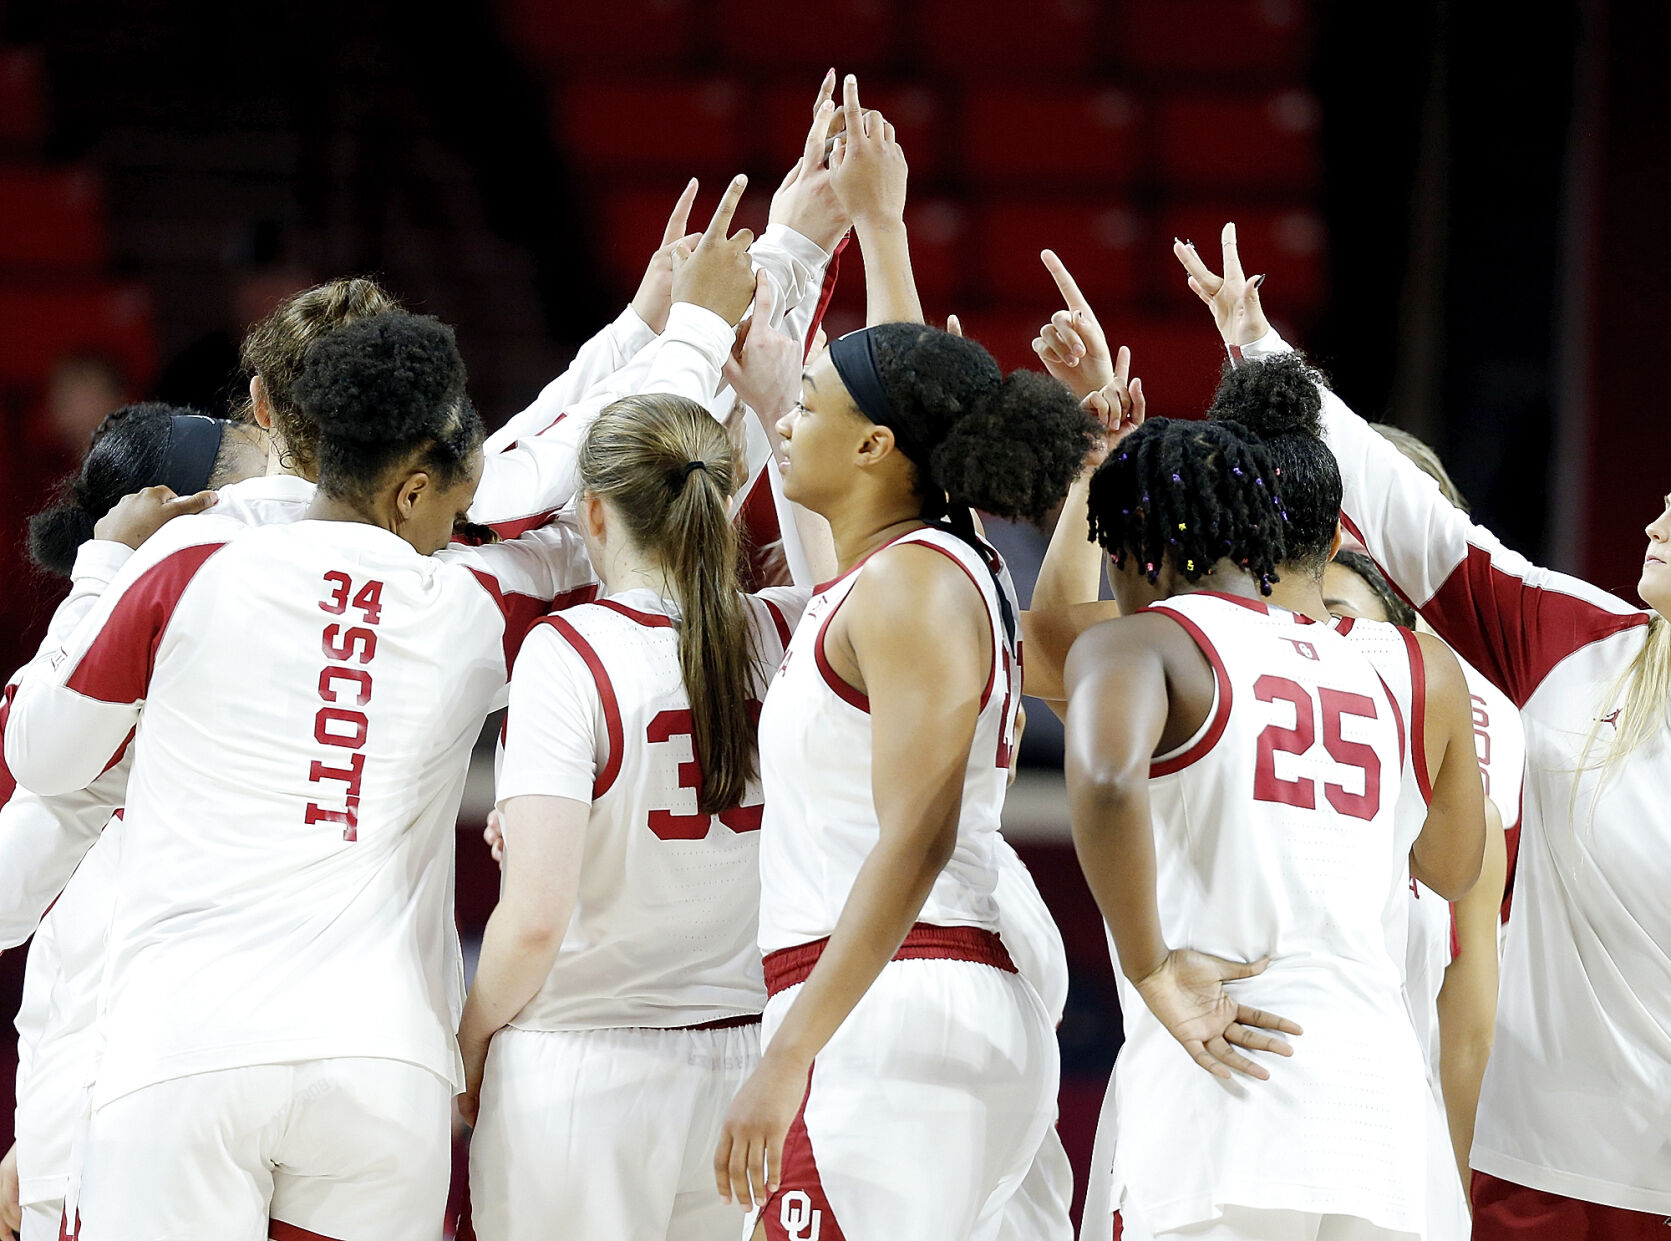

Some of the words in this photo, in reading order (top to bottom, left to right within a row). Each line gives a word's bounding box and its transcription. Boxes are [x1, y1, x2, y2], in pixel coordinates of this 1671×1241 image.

[318, 569, 384, 625] 34
[304, 622, 378, 842] SCOTT
[1253, 674, 1382, 821] 25
[780, 1189, 822, 1241] OU
